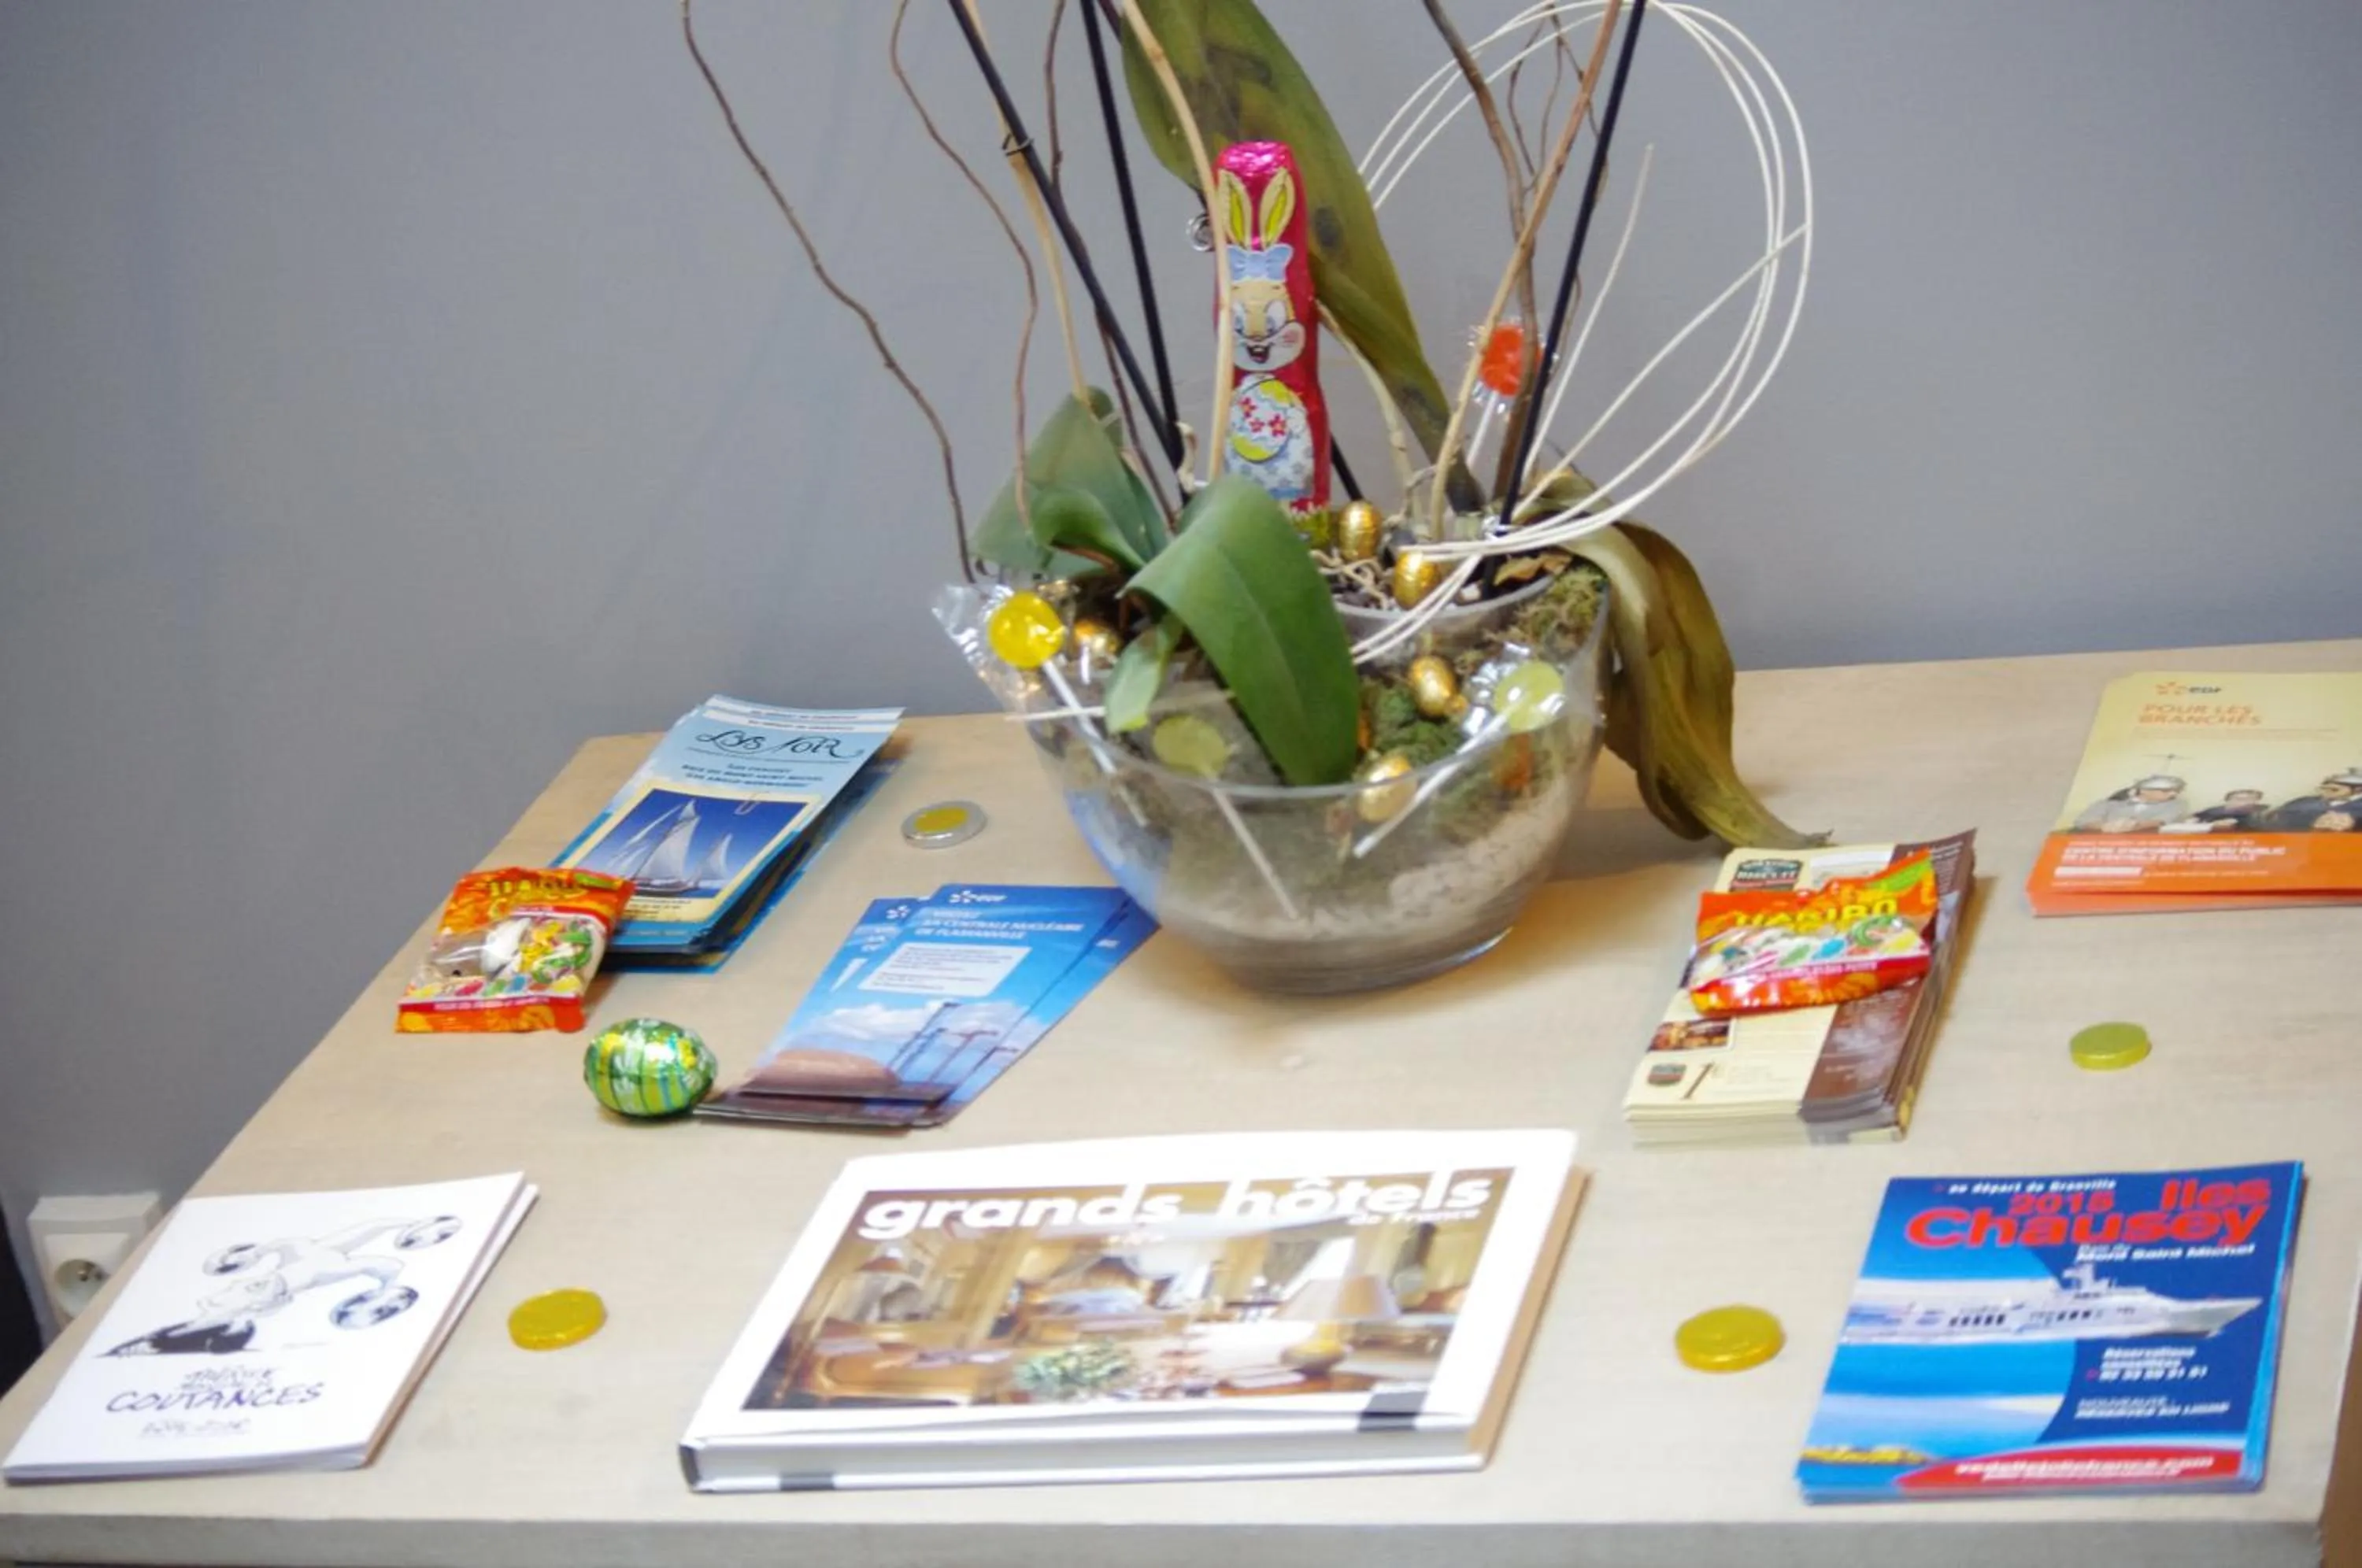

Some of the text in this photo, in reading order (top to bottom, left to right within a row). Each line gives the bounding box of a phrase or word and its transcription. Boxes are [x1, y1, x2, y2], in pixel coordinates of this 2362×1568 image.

[857, 1170, 1493, 1241] grands hôtels
[1904, 1205, 2269, 1249] Chausey
